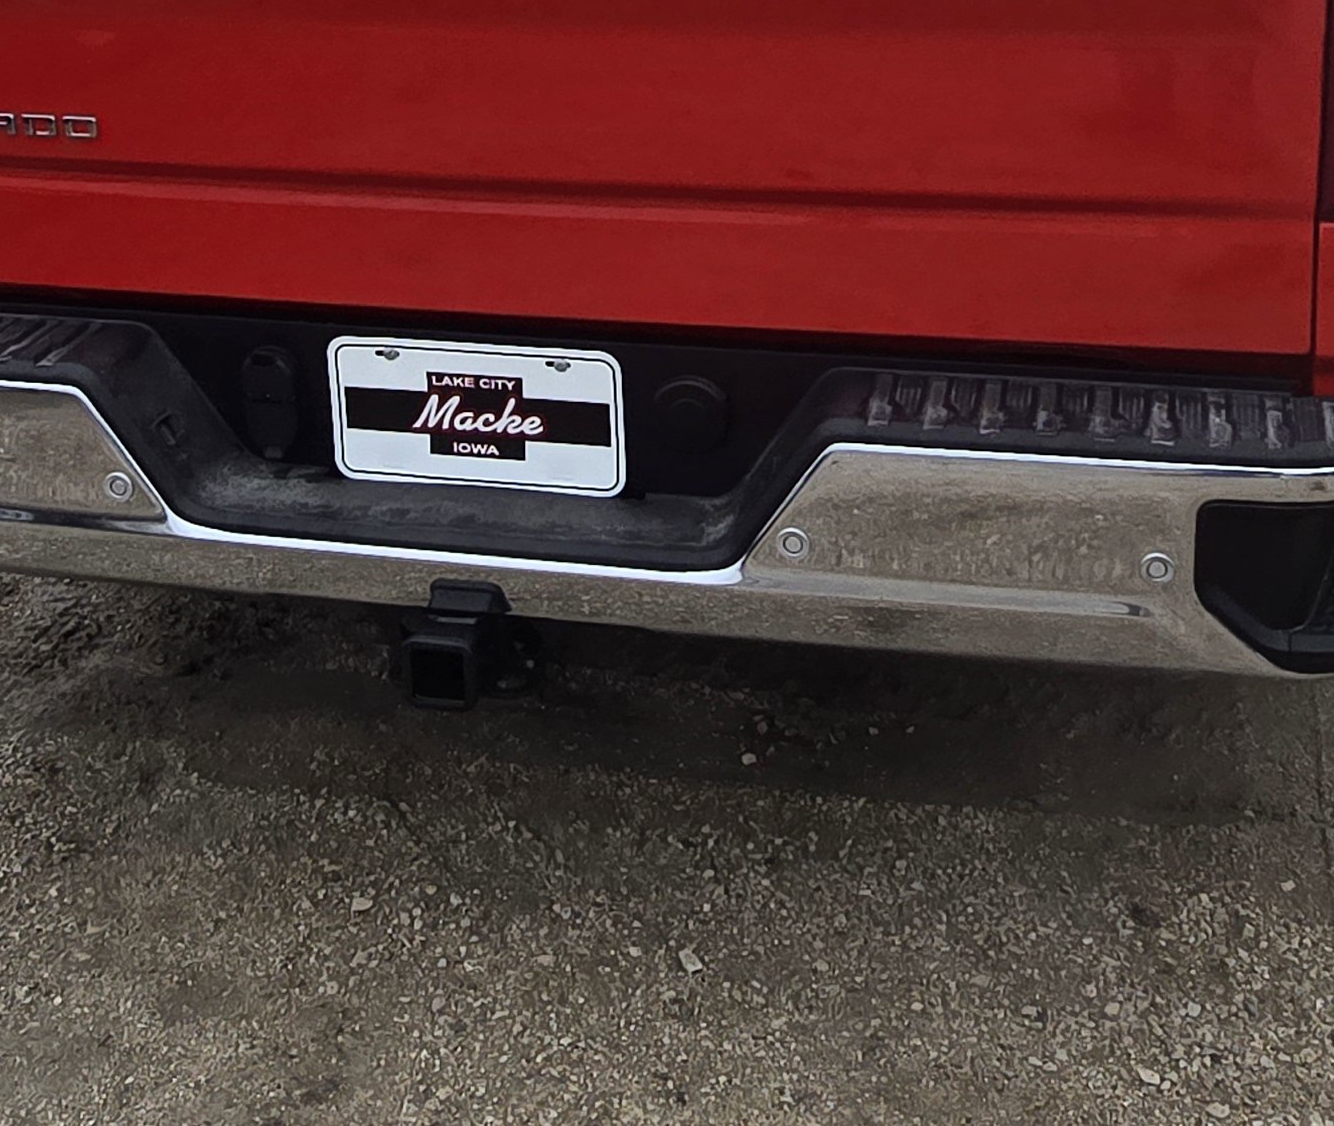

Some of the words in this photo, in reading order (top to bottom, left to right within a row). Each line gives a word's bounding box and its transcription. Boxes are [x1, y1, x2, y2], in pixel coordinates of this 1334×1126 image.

[431, 375, 475, 389] LAKE
[479, 377, 516, 392] CITY
[412, 394, 544, 436] Macke
[453, 441, 500, 456] IOWA
